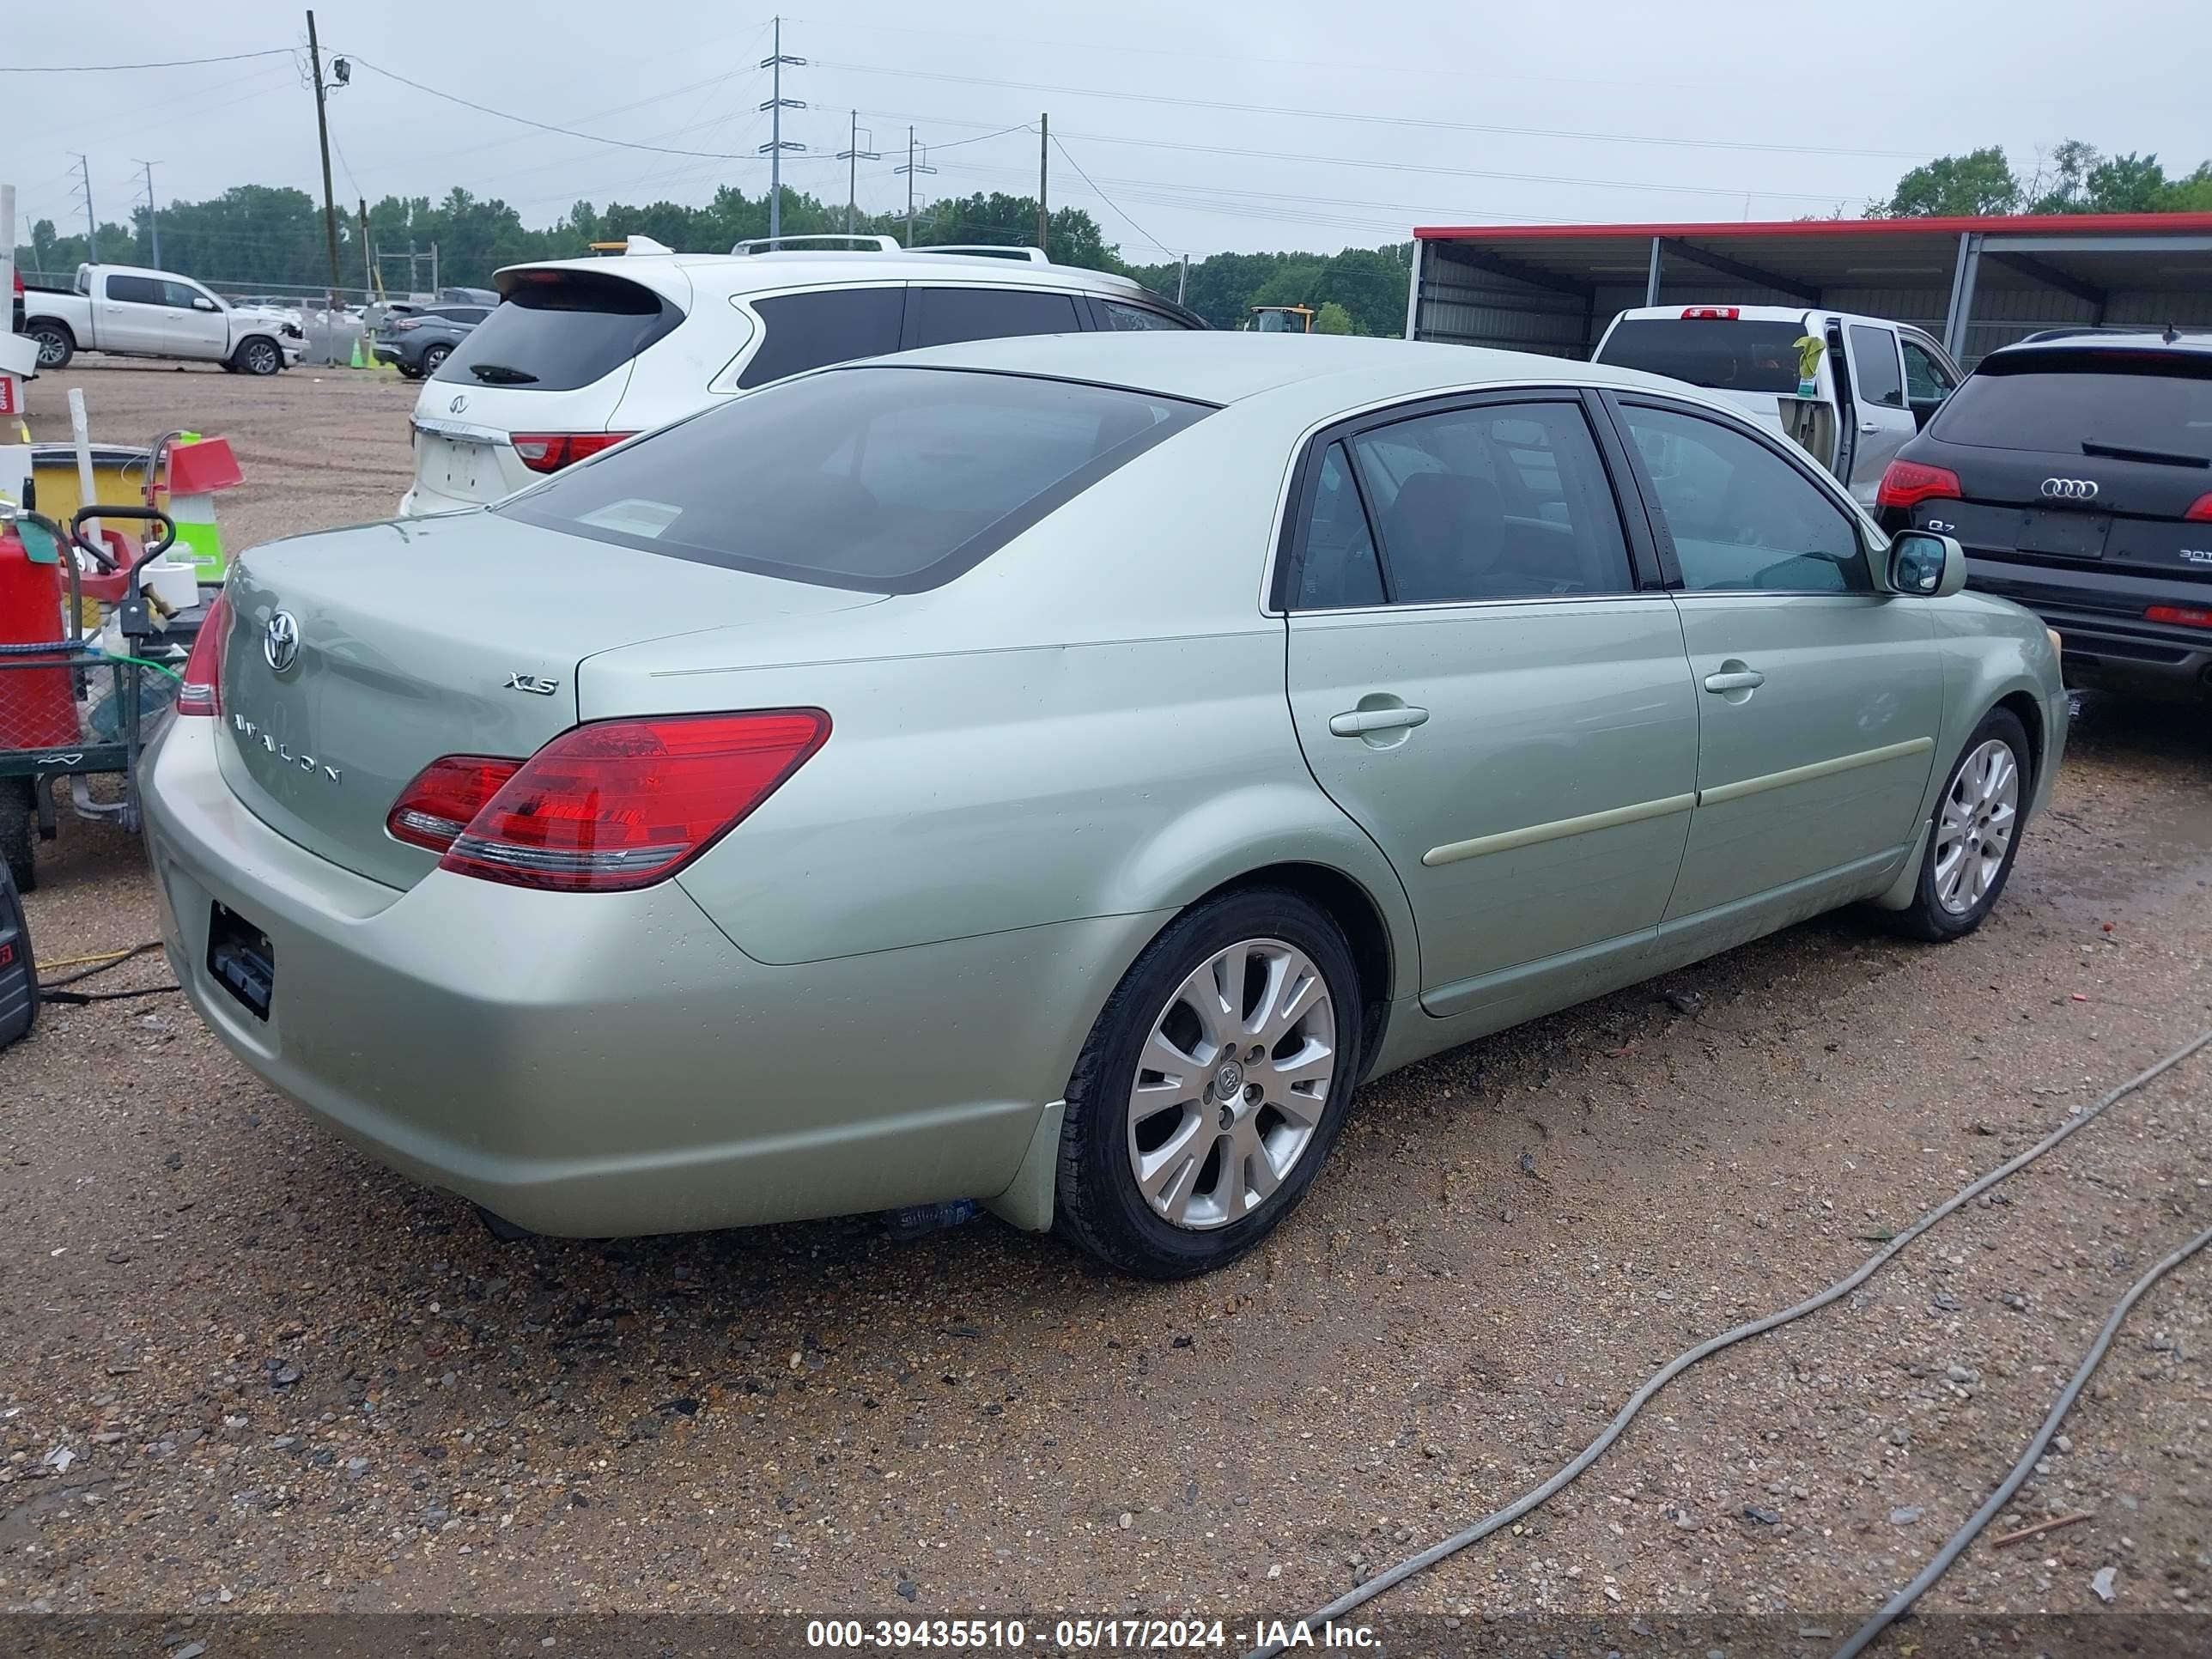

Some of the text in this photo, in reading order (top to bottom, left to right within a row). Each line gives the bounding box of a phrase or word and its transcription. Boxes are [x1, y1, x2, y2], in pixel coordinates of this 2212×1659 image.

[1928, 520, 1955, 532] Q7
[502, 672, 559, 696] XLS
[234, 714, 343, 785] AVALON
